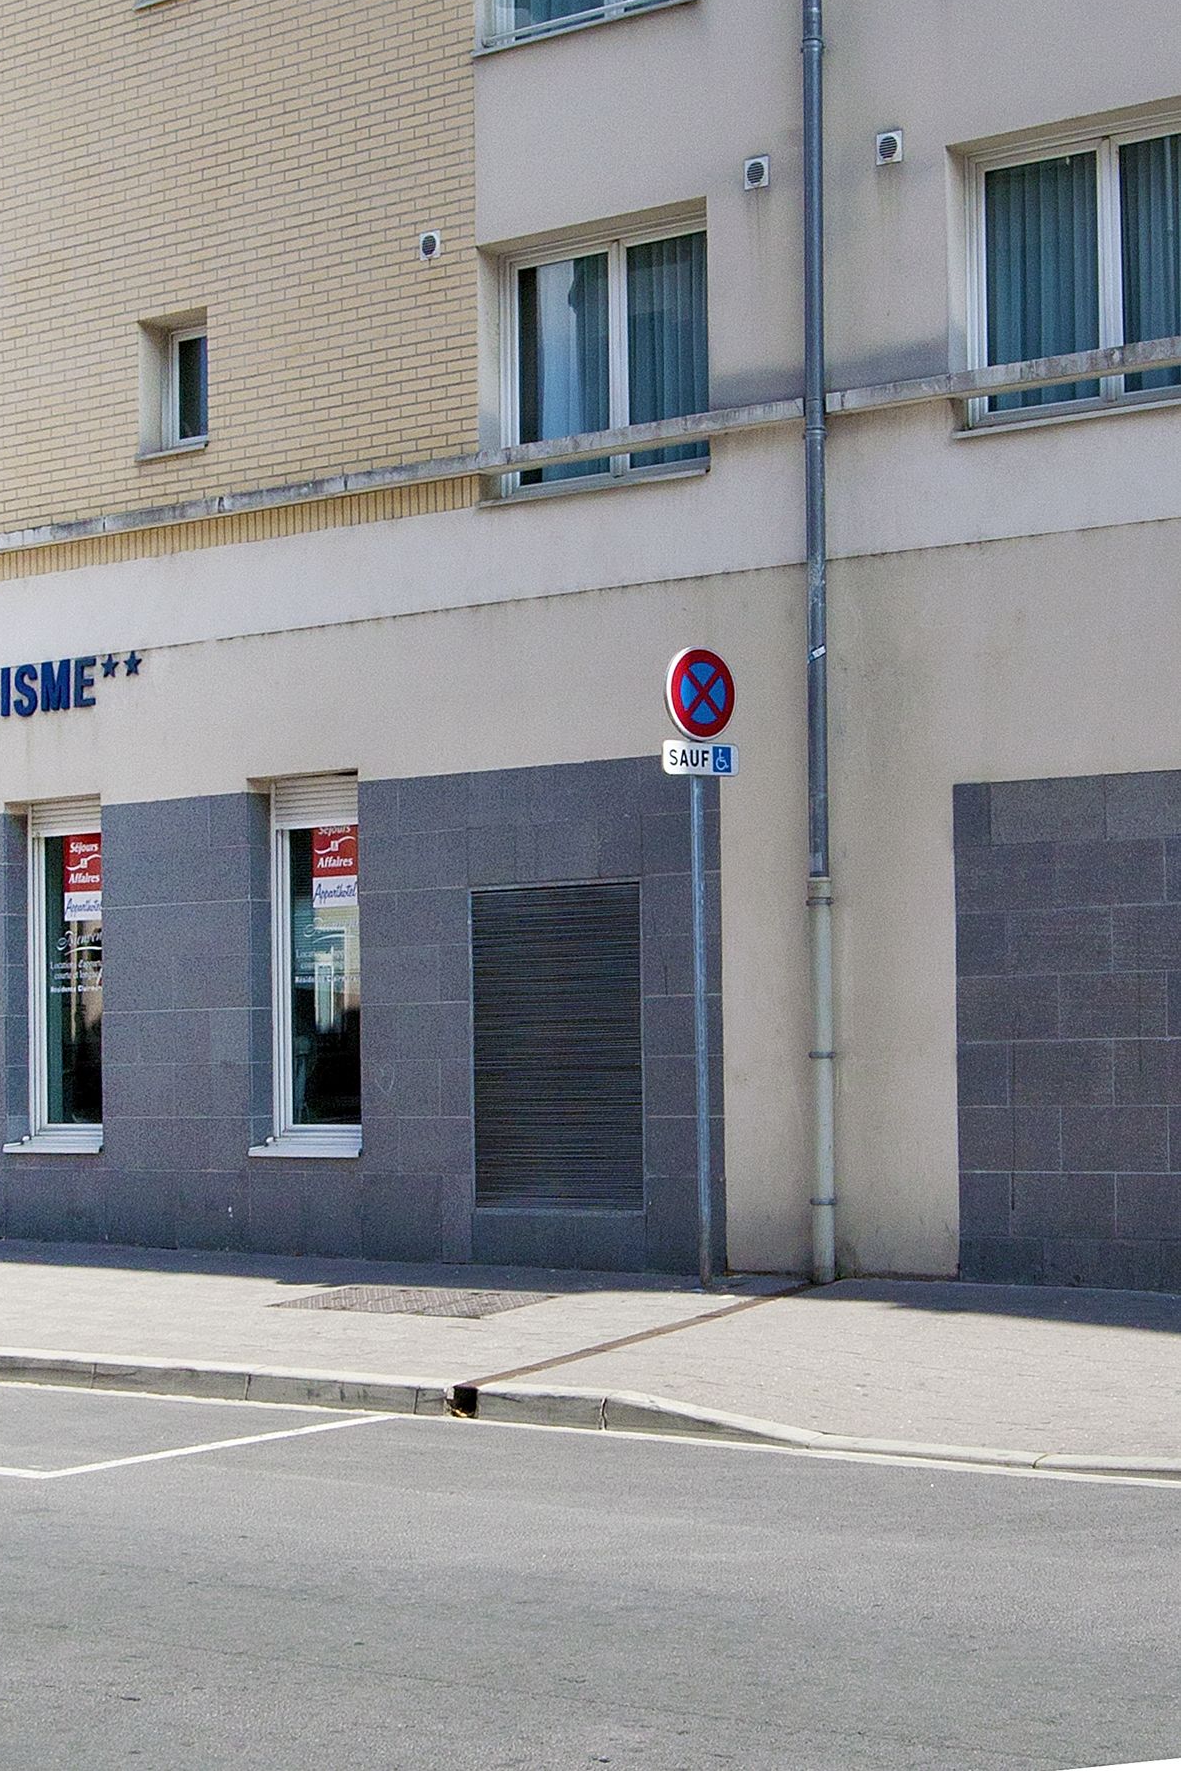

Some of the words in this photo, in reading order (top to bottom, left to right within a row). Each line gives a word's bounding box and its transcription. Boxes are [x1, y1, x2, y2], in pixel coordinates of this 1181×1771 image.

[669, 748, 710, 768] SAUF
[317, 855, 354, 869] Affaires
[68, 874, 102, 886] Affaires
